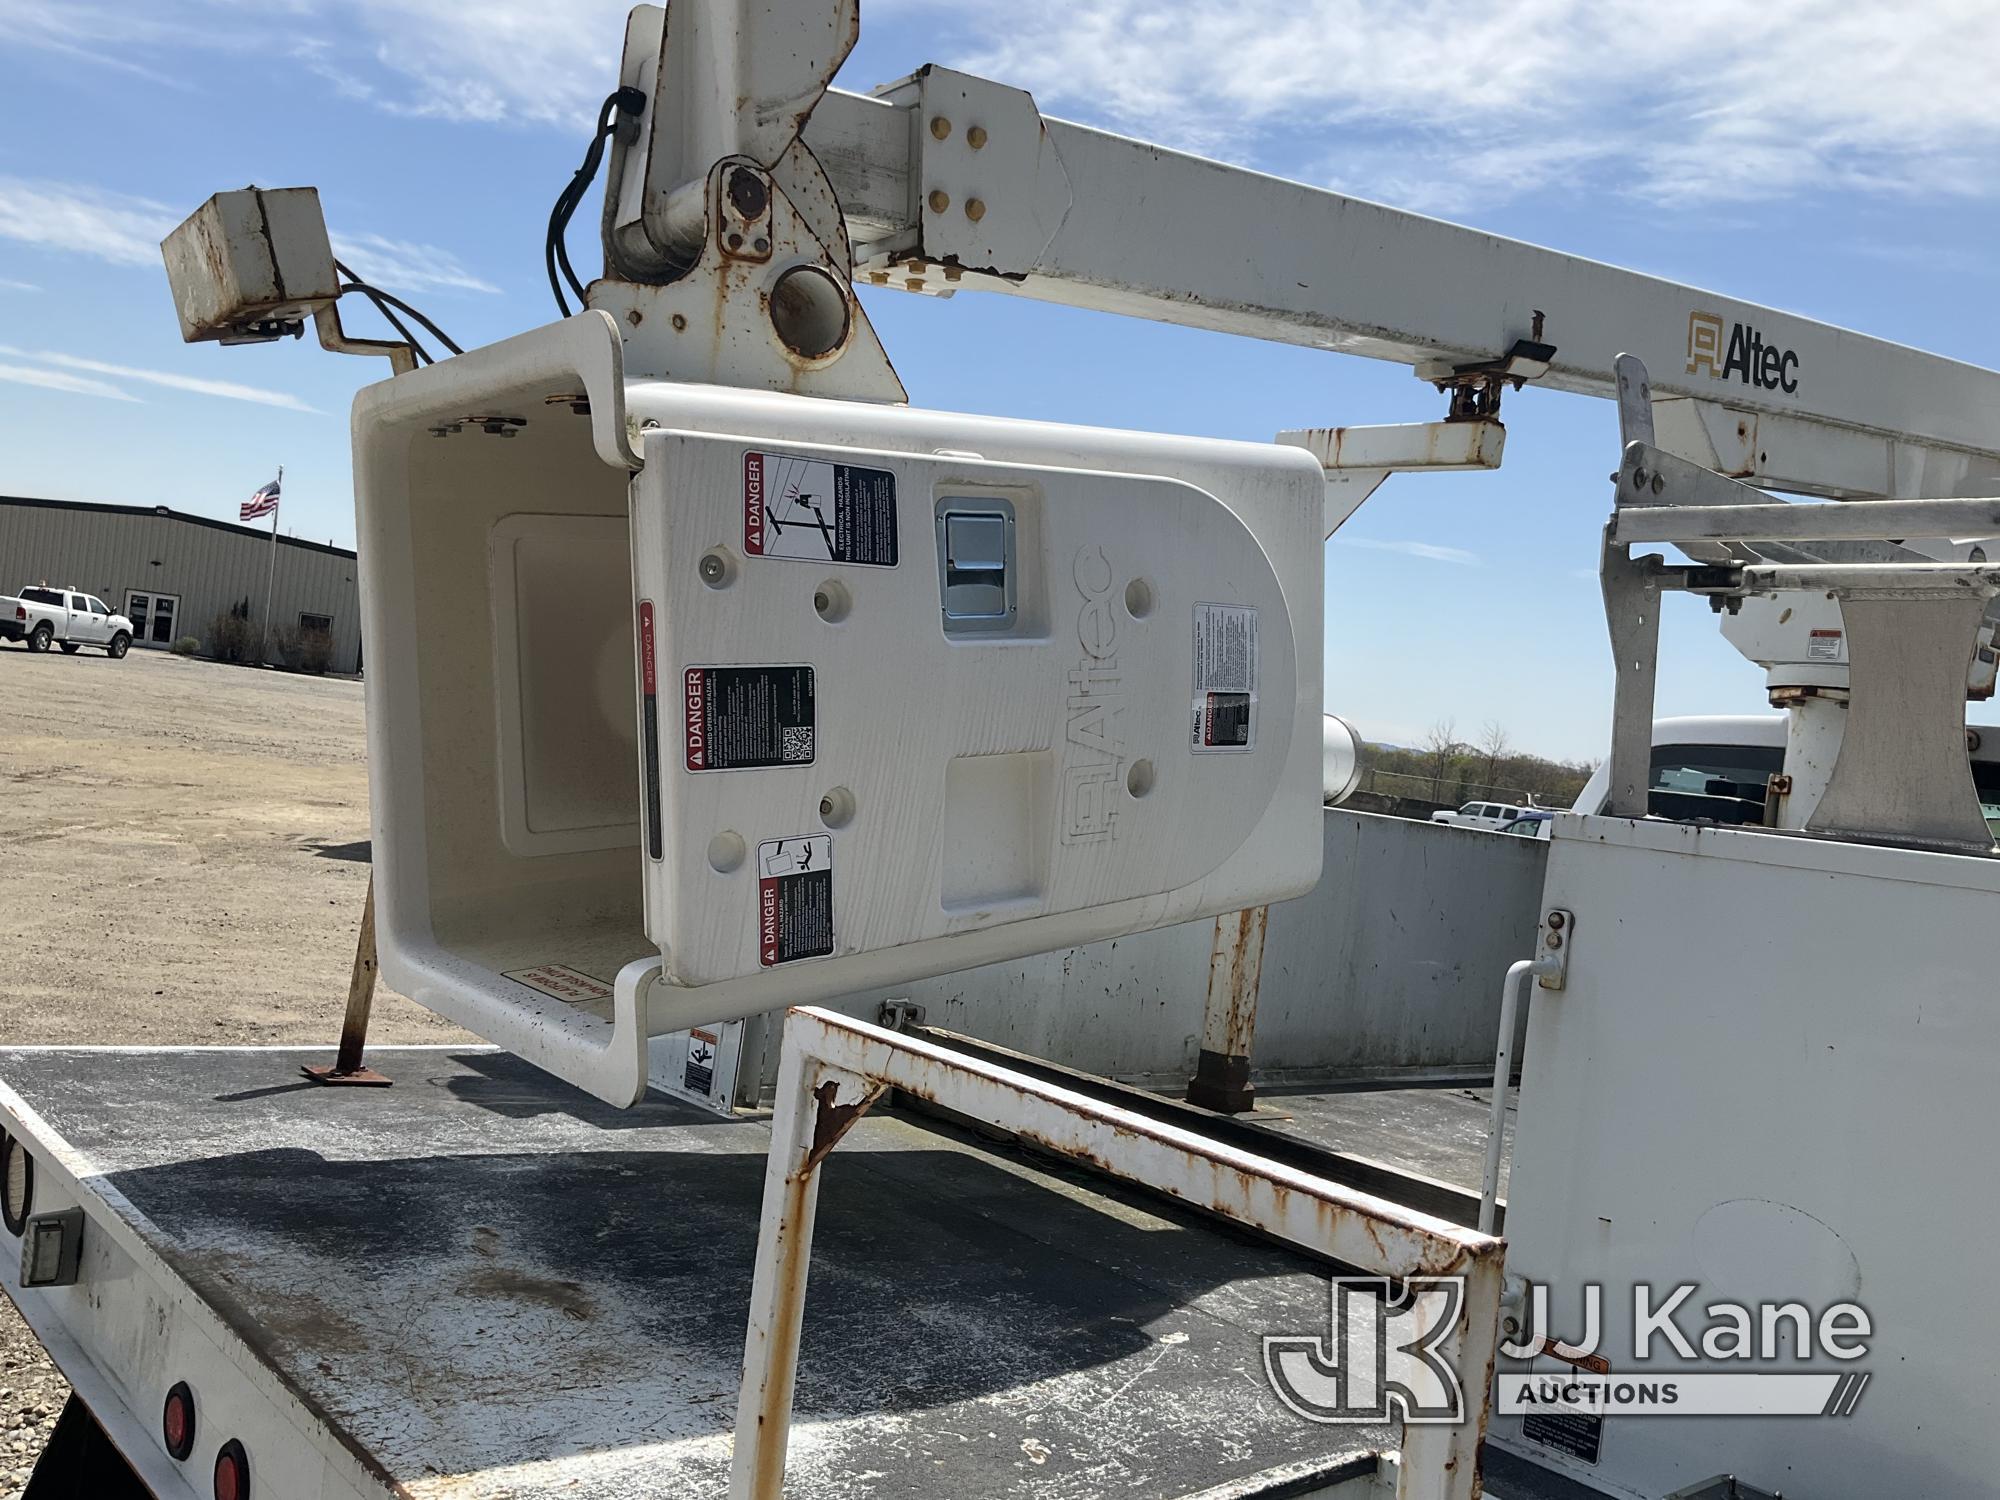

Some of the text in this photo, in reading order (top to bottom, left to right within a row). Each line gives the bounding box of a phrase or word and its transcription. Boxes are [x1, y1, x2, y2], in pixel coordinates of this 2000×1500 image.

[1721, 323, 1799, 394] Altec
[749, 461, 760, 526] DANGER
[645, 634, 653, 687] DANGER
[1065, 543, 1125, 758] Altec
[689, 672, 702, 748] DANGER
[764, 888, 775, 944] DANGER
